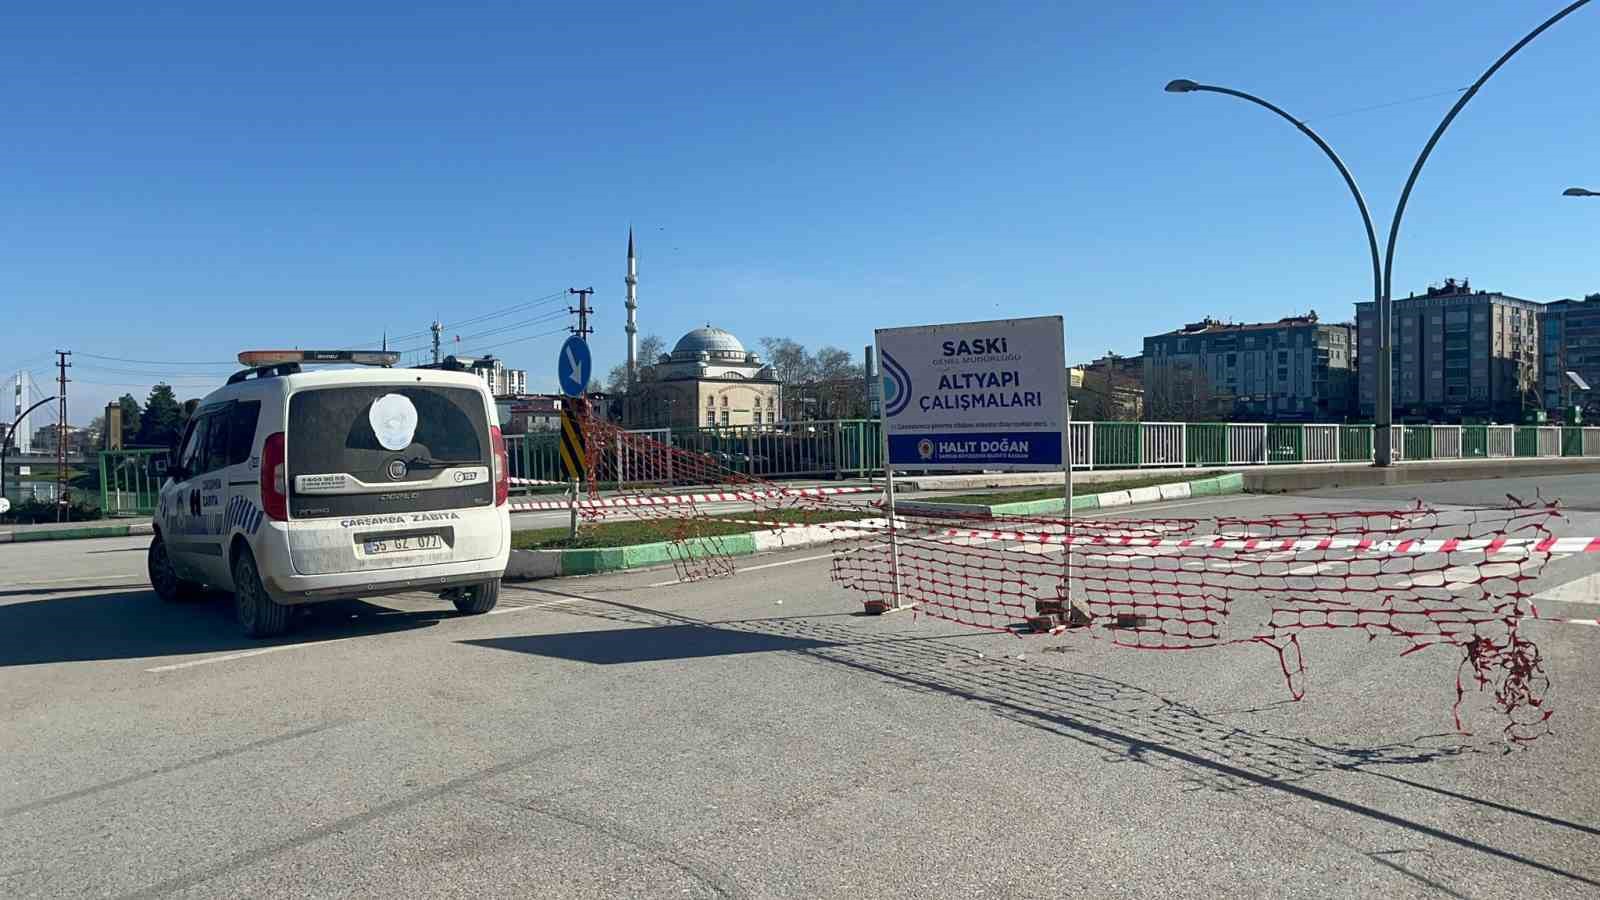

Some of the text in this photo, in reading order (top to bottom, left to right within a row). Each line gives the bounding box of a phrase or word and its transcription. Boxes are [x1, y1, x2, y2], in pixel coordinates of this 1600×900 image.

[942, 337, 1008, 356] SASKİ
[938, 371, 1020, 390] ALTYAPI
[919, 392, 1041, 412] ÇALIŞMALARI
[980, 438, 1029, 452] DOĞAN
[411, 512, 460, 522] ZABITA
